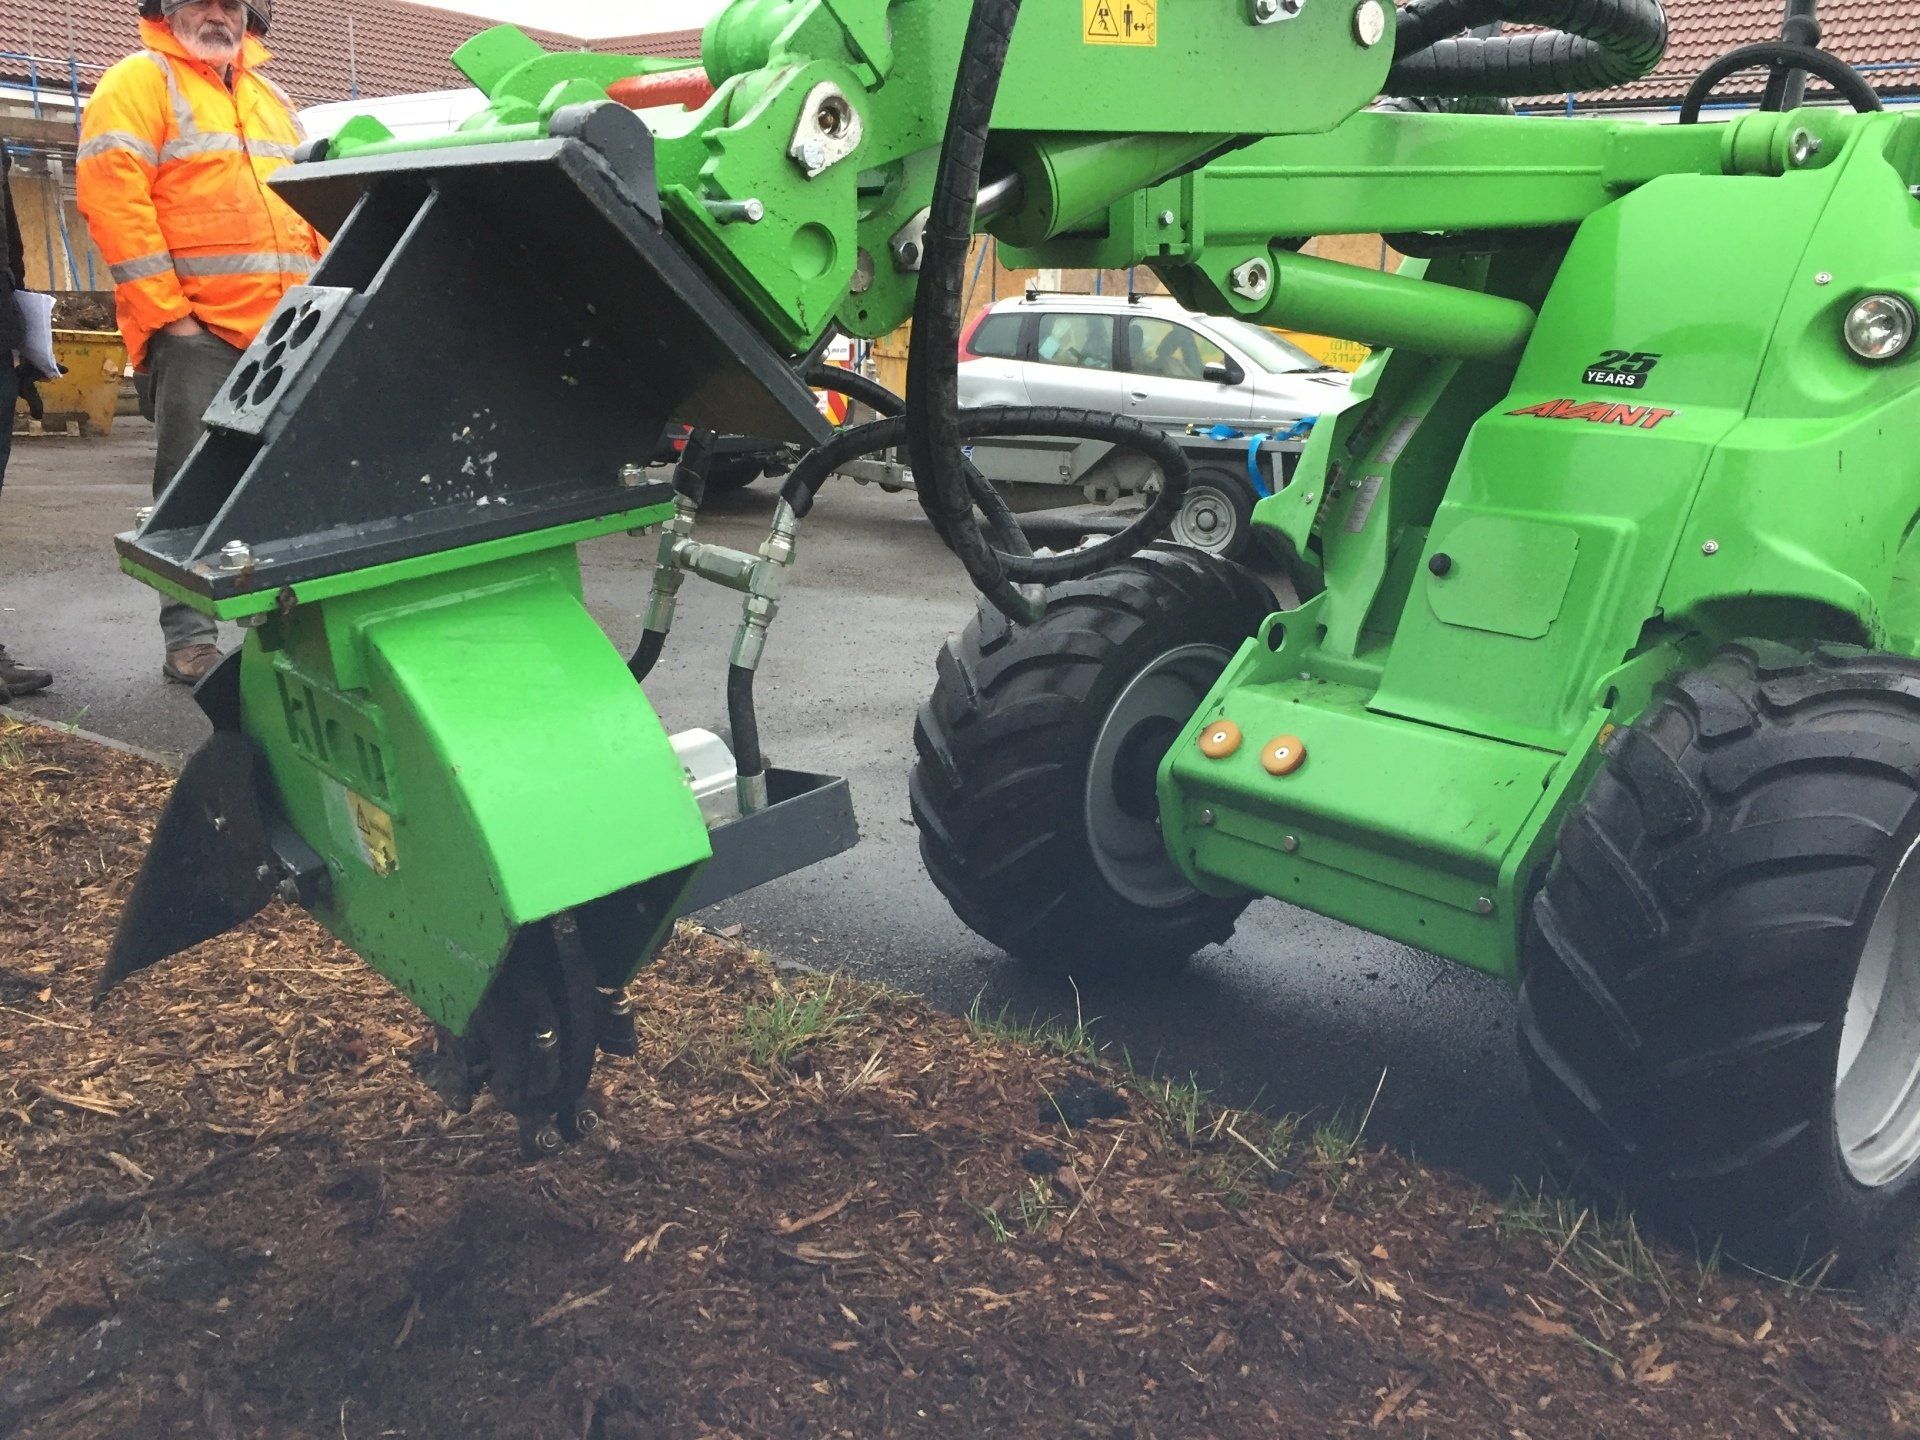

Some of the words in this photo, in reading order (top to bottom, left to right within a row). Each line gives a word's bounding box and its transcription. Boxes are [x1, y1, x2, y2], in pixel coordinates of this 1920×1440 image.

[1586, 349, 1663, 374] 25
[1586, 371, 1636, 385] YEARS
[1503, 398, 1675, 429] AVANT
